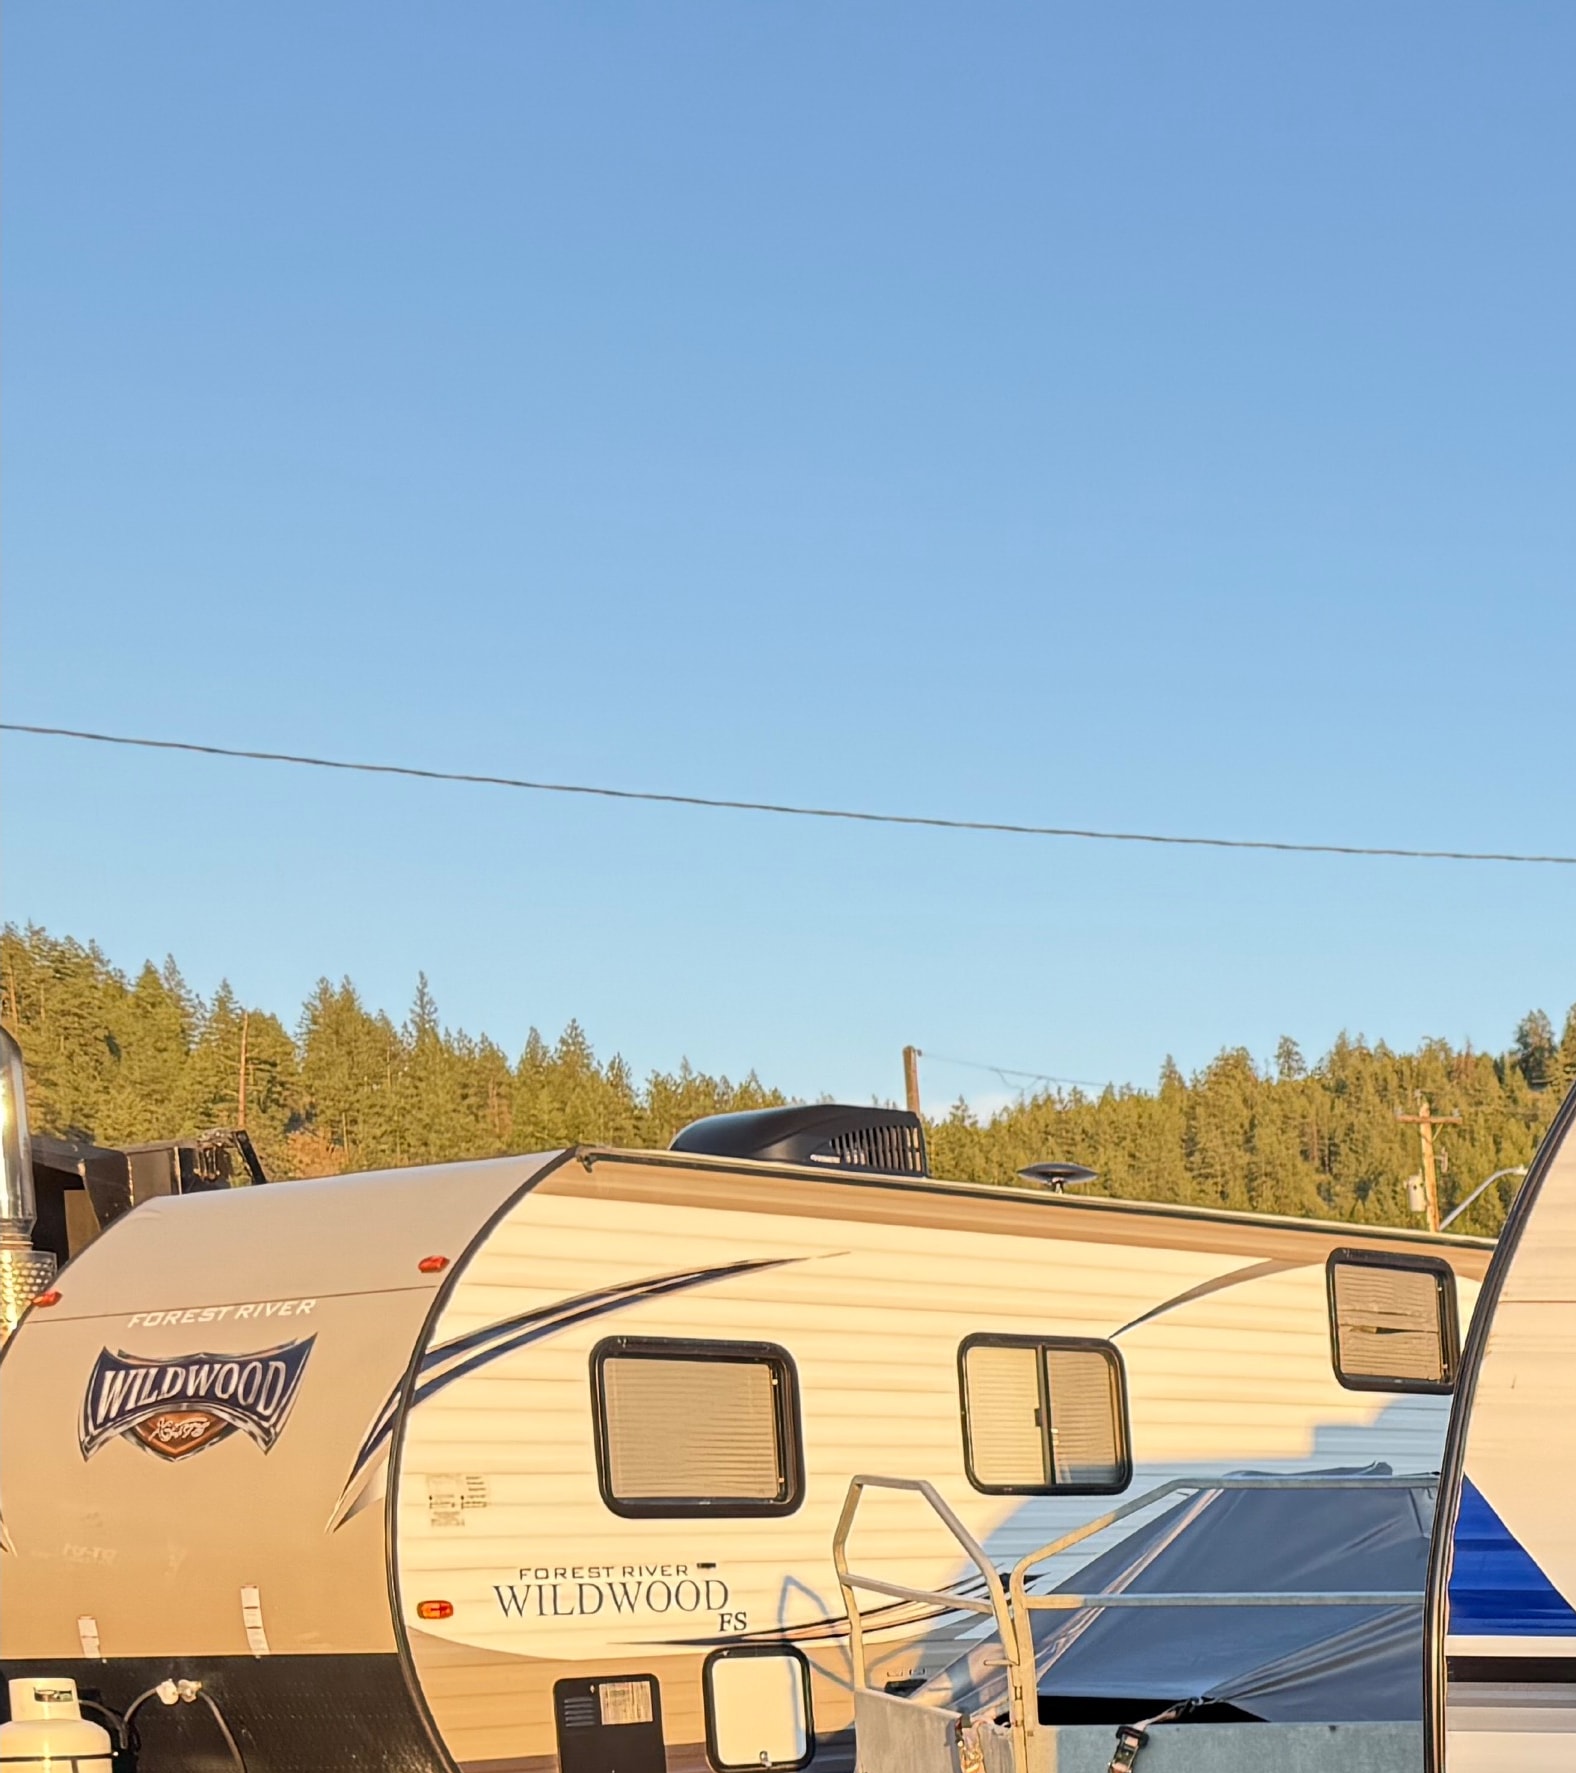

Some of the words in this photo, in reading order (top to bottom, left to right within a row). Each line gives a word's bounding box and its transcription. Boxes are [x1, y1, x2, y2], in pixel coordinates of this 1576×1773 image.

[127, 1305, 235, 1328] FOREST
[234, 1299, 317, 1320] RIVER
[96, 1361, 287, 1425] WILDWOOD
[519, 1566, 615, 1581] FOREST
[622, 1564, 689, 1577] RIVER
[493, 1579, 729, 1618] WILDWOOD
[718, 1611, 748, 1632] FS
